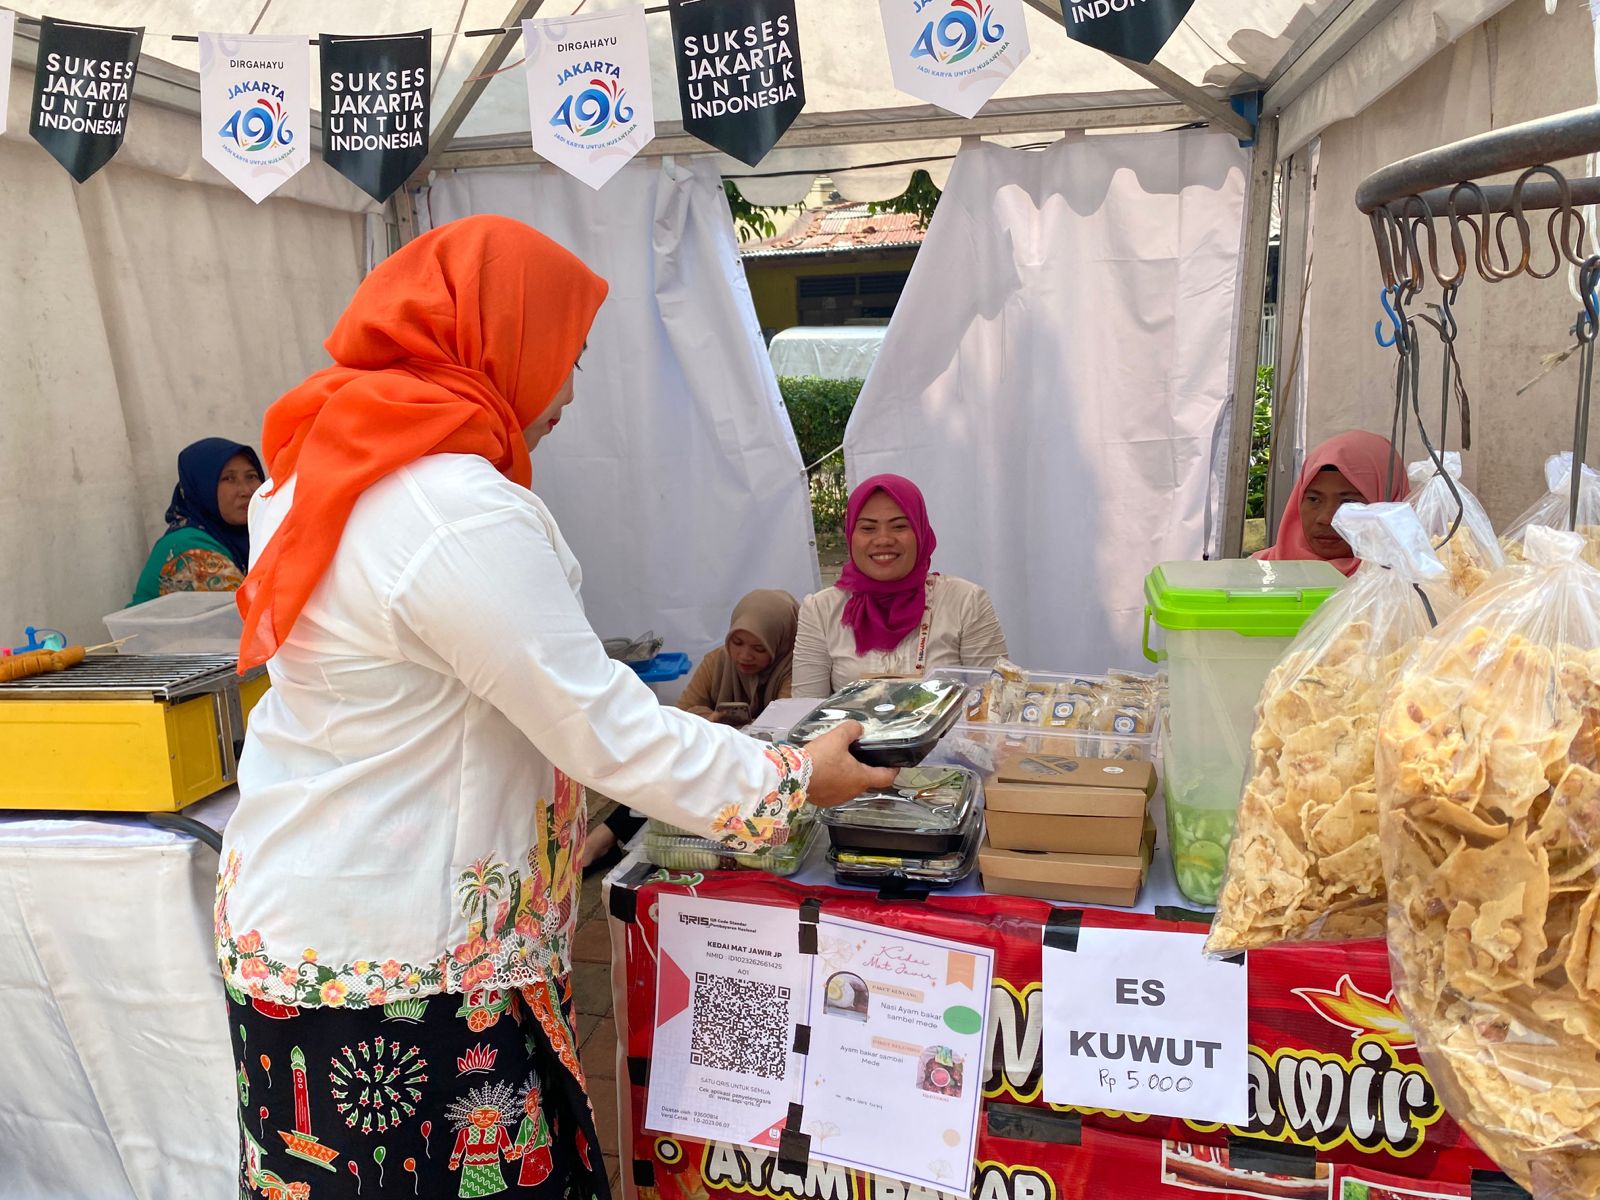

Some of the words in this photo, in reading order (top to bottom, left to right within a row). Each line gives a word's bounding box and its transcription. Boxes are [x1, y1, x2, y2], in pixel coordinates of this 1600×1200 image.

[1072, 0, 1145, 23] INDO
[557, 37, 617, 52] DIRGAHAYU
[684, 15, 789, 56] SUKSES
[910, 8, 1005, 62] 496
[46, 53, 134, 80] SUKSES
[230, 59, 284, 70] DIRGAHAYU
[688, 40, 793, 80] JAKARTA
[917, 65, 930, 74] JADI
[931, 70, 953, 78] KARYA
[954, 68, 976, 77] UNTUK
[976, 41, 1010, 71] NUSANTARA
[330, 67, 425, 92] SUKSES
[557, 61, 620, 86] JAKARTA
[687, 62, 795, 101] UNTUK
[43, 74, 128, 101] JAKARTA
[228, 80, 285, 102] JAKARTA
[41, 94, 126, 119] UNTUK
[331, 91, 424, 115] JAKARTA
[549, 89, 634, 134] 496
[691, 83, 797, 119] INDONESIA
[39, 111, 122, 135] INDONESIA
[218, 107, 294, 149] 496
[331, 112, 424, 134] UNTUK
[331, 131, 423, 151] INDONESIA
[566, 140, 585, 149] KARYA
[606, 124, 637, 146] NUSANTARA
[679, 914, 709, 927] QRIS
[706, 951, 724, 960] NMID
[707, 941, 730, 950] KEDAI
[731, 944, 748, 953] MAT
[748, 947, 772, 957] JAWIR
[862, 956, 892, 971] Mat
[1116, 978, 1166, 1007] ES
[881, 1001, 897, 1011] Nasi
[897, 1005, 919, 1015] Ayam
[920, 1010, 942, 1020] bakar
[915, 1019, 938, 1029] mede
[840, 1044, 859, 1053] Ayam
[1069, 1030, 1222, 1069] KUWUT
[730, 1083, 749, 1091] UNTUK
[750, 1086, 771, 1095] SEMUA
[1098, 1068, 1117, 1093] Rp
[1127, 1070, 1193, 1092] 5.000
[1248, 1043, 1428, 1144] awir
